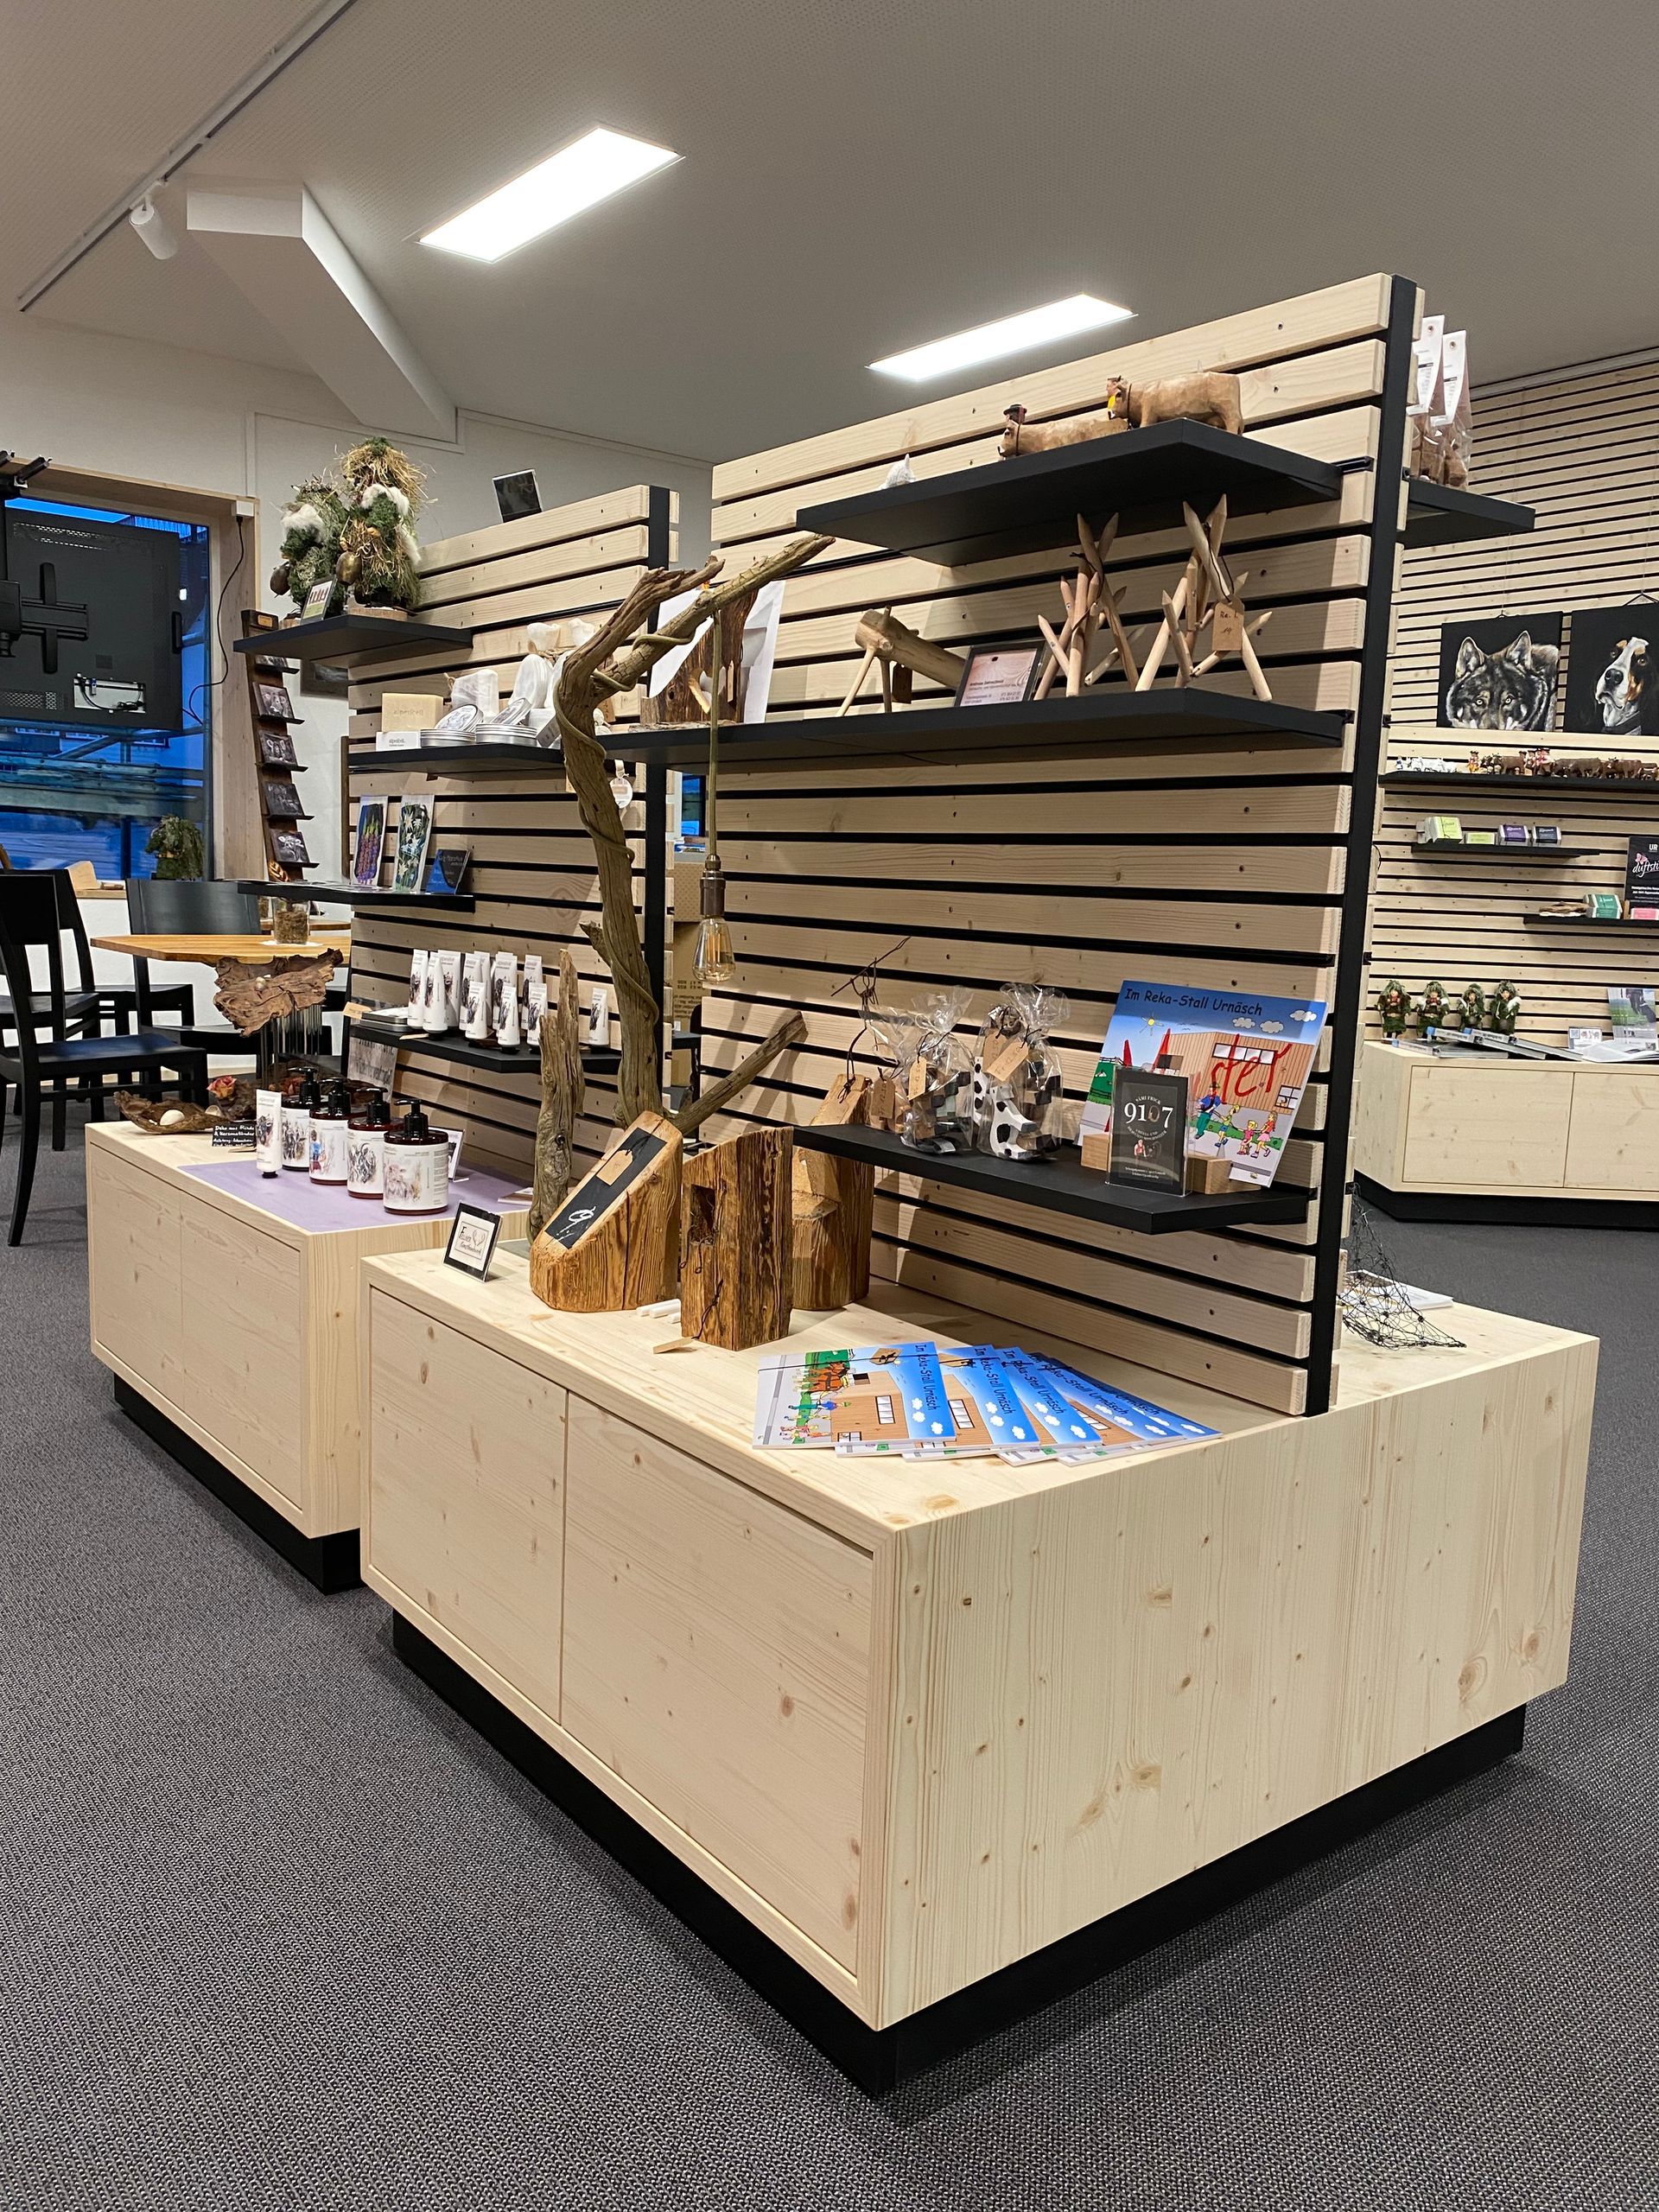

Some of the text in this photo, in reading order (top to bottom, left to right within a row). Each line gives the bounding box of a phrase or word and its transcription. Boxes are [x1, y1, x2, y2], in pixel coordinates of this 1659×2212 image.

[1124, 988, 1262, 1016] Im Reka-Stall Urnäsch
[1124, 1102, 1174, 1128] 9107
[923, 1384, 941, 1411] Urnäsch
[994, 1389, 1017, 1414] Urnäsch
[1037, 1389, 1067, 1414] Urnäsch
[1089, 1392, 1129, 1414] Urnäsch
